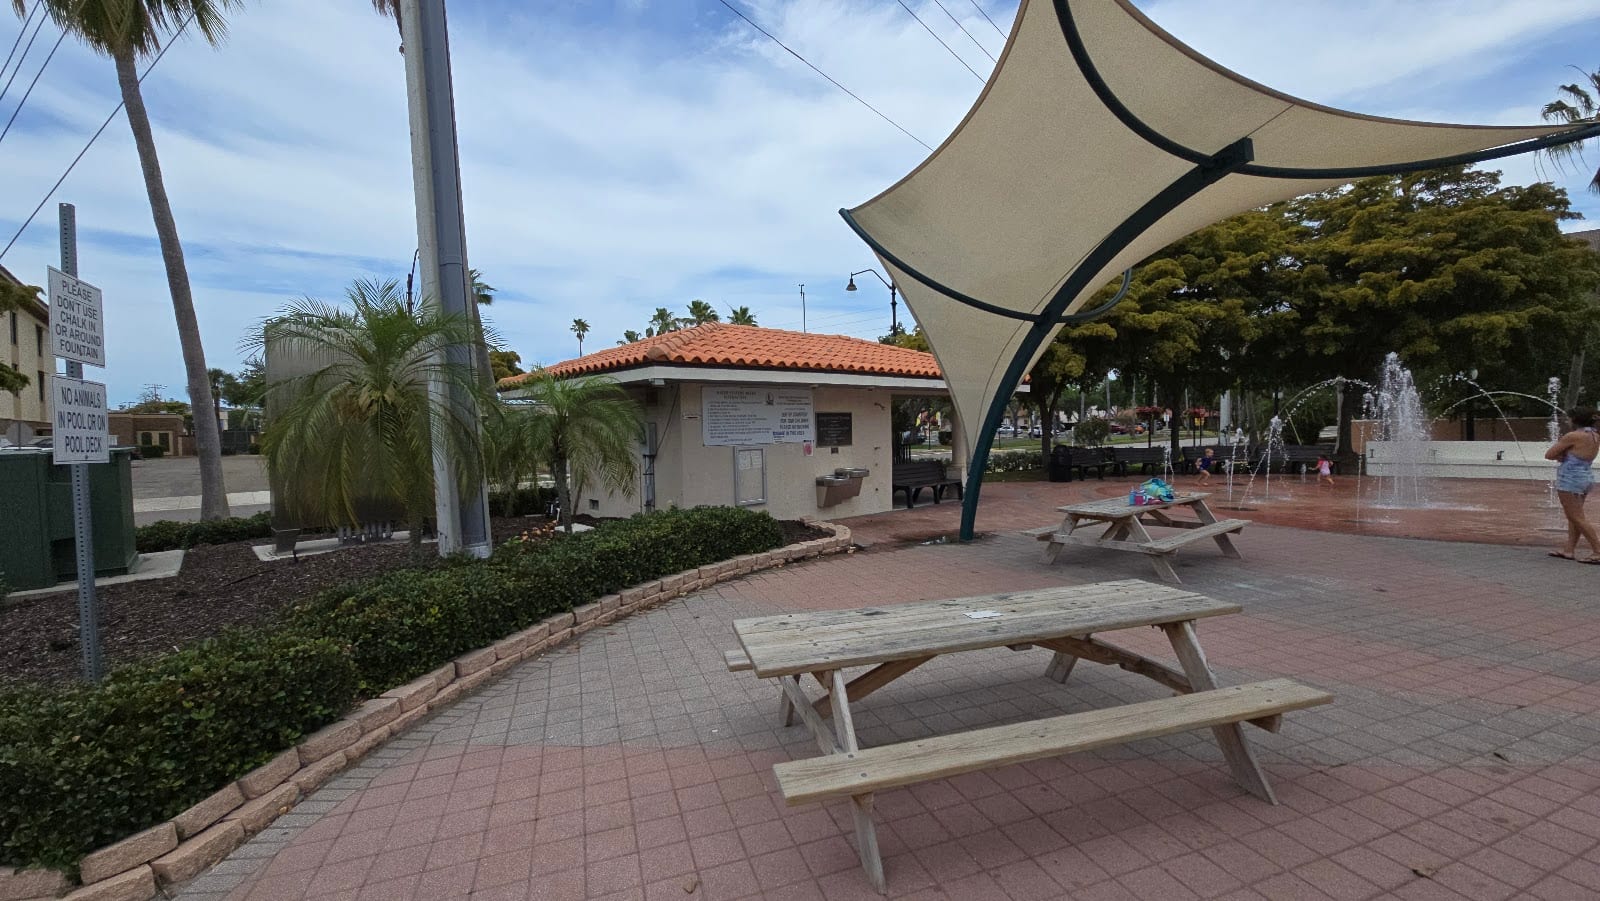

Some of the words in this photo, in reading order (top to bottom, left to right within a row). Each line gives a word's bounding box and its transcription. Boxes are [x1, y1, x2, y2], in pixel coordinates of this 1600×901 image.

[62, 280, 92, 302] PLEASE
[60, 311, 87, 330] CHALK
[88, 321, 96, 332] IN
[82, 307, 97, 320] USE
[56, 324, 68, 337] OR
[70, 328, 101, 347] AROUND
[60, 339, 98, 359] FOUNTAIN
[62, 386, 72, 405] NO
[74, 389, 101, 408] ANIMALS
[58, 411, 66, 428] IN
[67, 412, 86, 430] POOL
[88, 414, 96, 430] OR
[98, 414, 106, 430] ON
[65, 436, 84, 452] POOL
[86, 436, 102, 452] DECK
